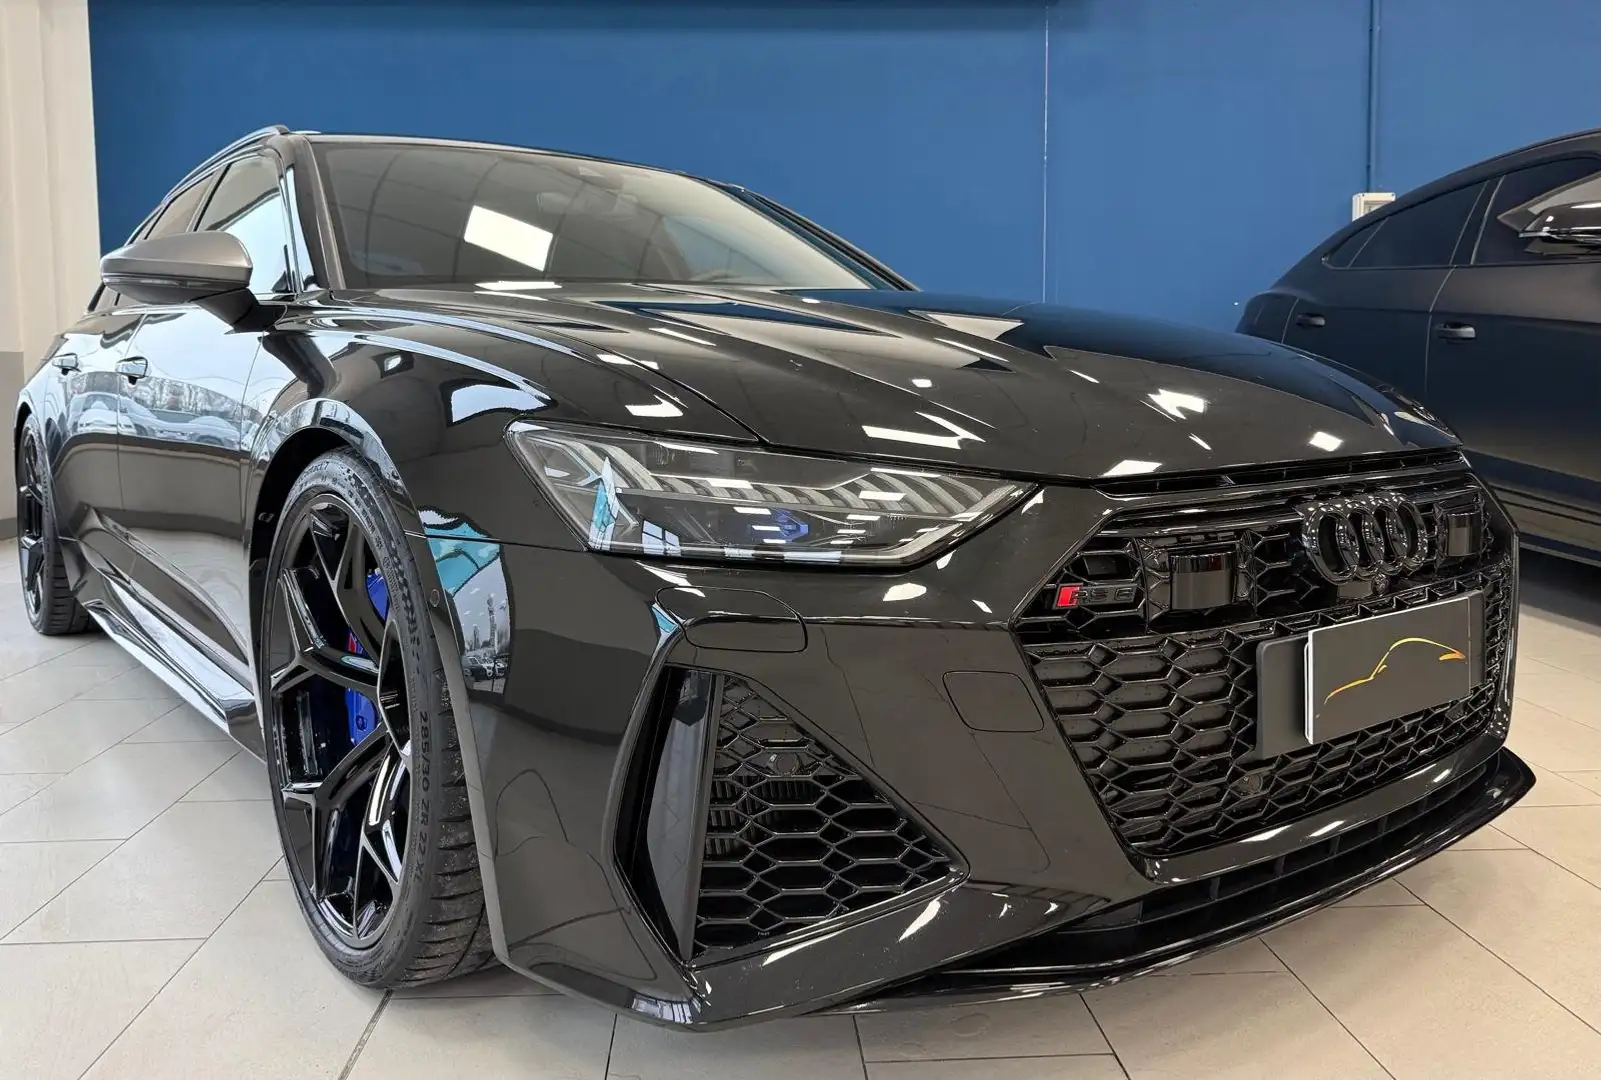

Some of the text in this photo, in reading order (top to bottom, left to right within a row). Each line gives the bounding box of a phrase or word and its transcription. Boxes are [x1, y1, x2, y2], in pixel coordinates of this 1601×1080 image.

[413, 711, 430, 883] 285/30 ZR 22 XL
